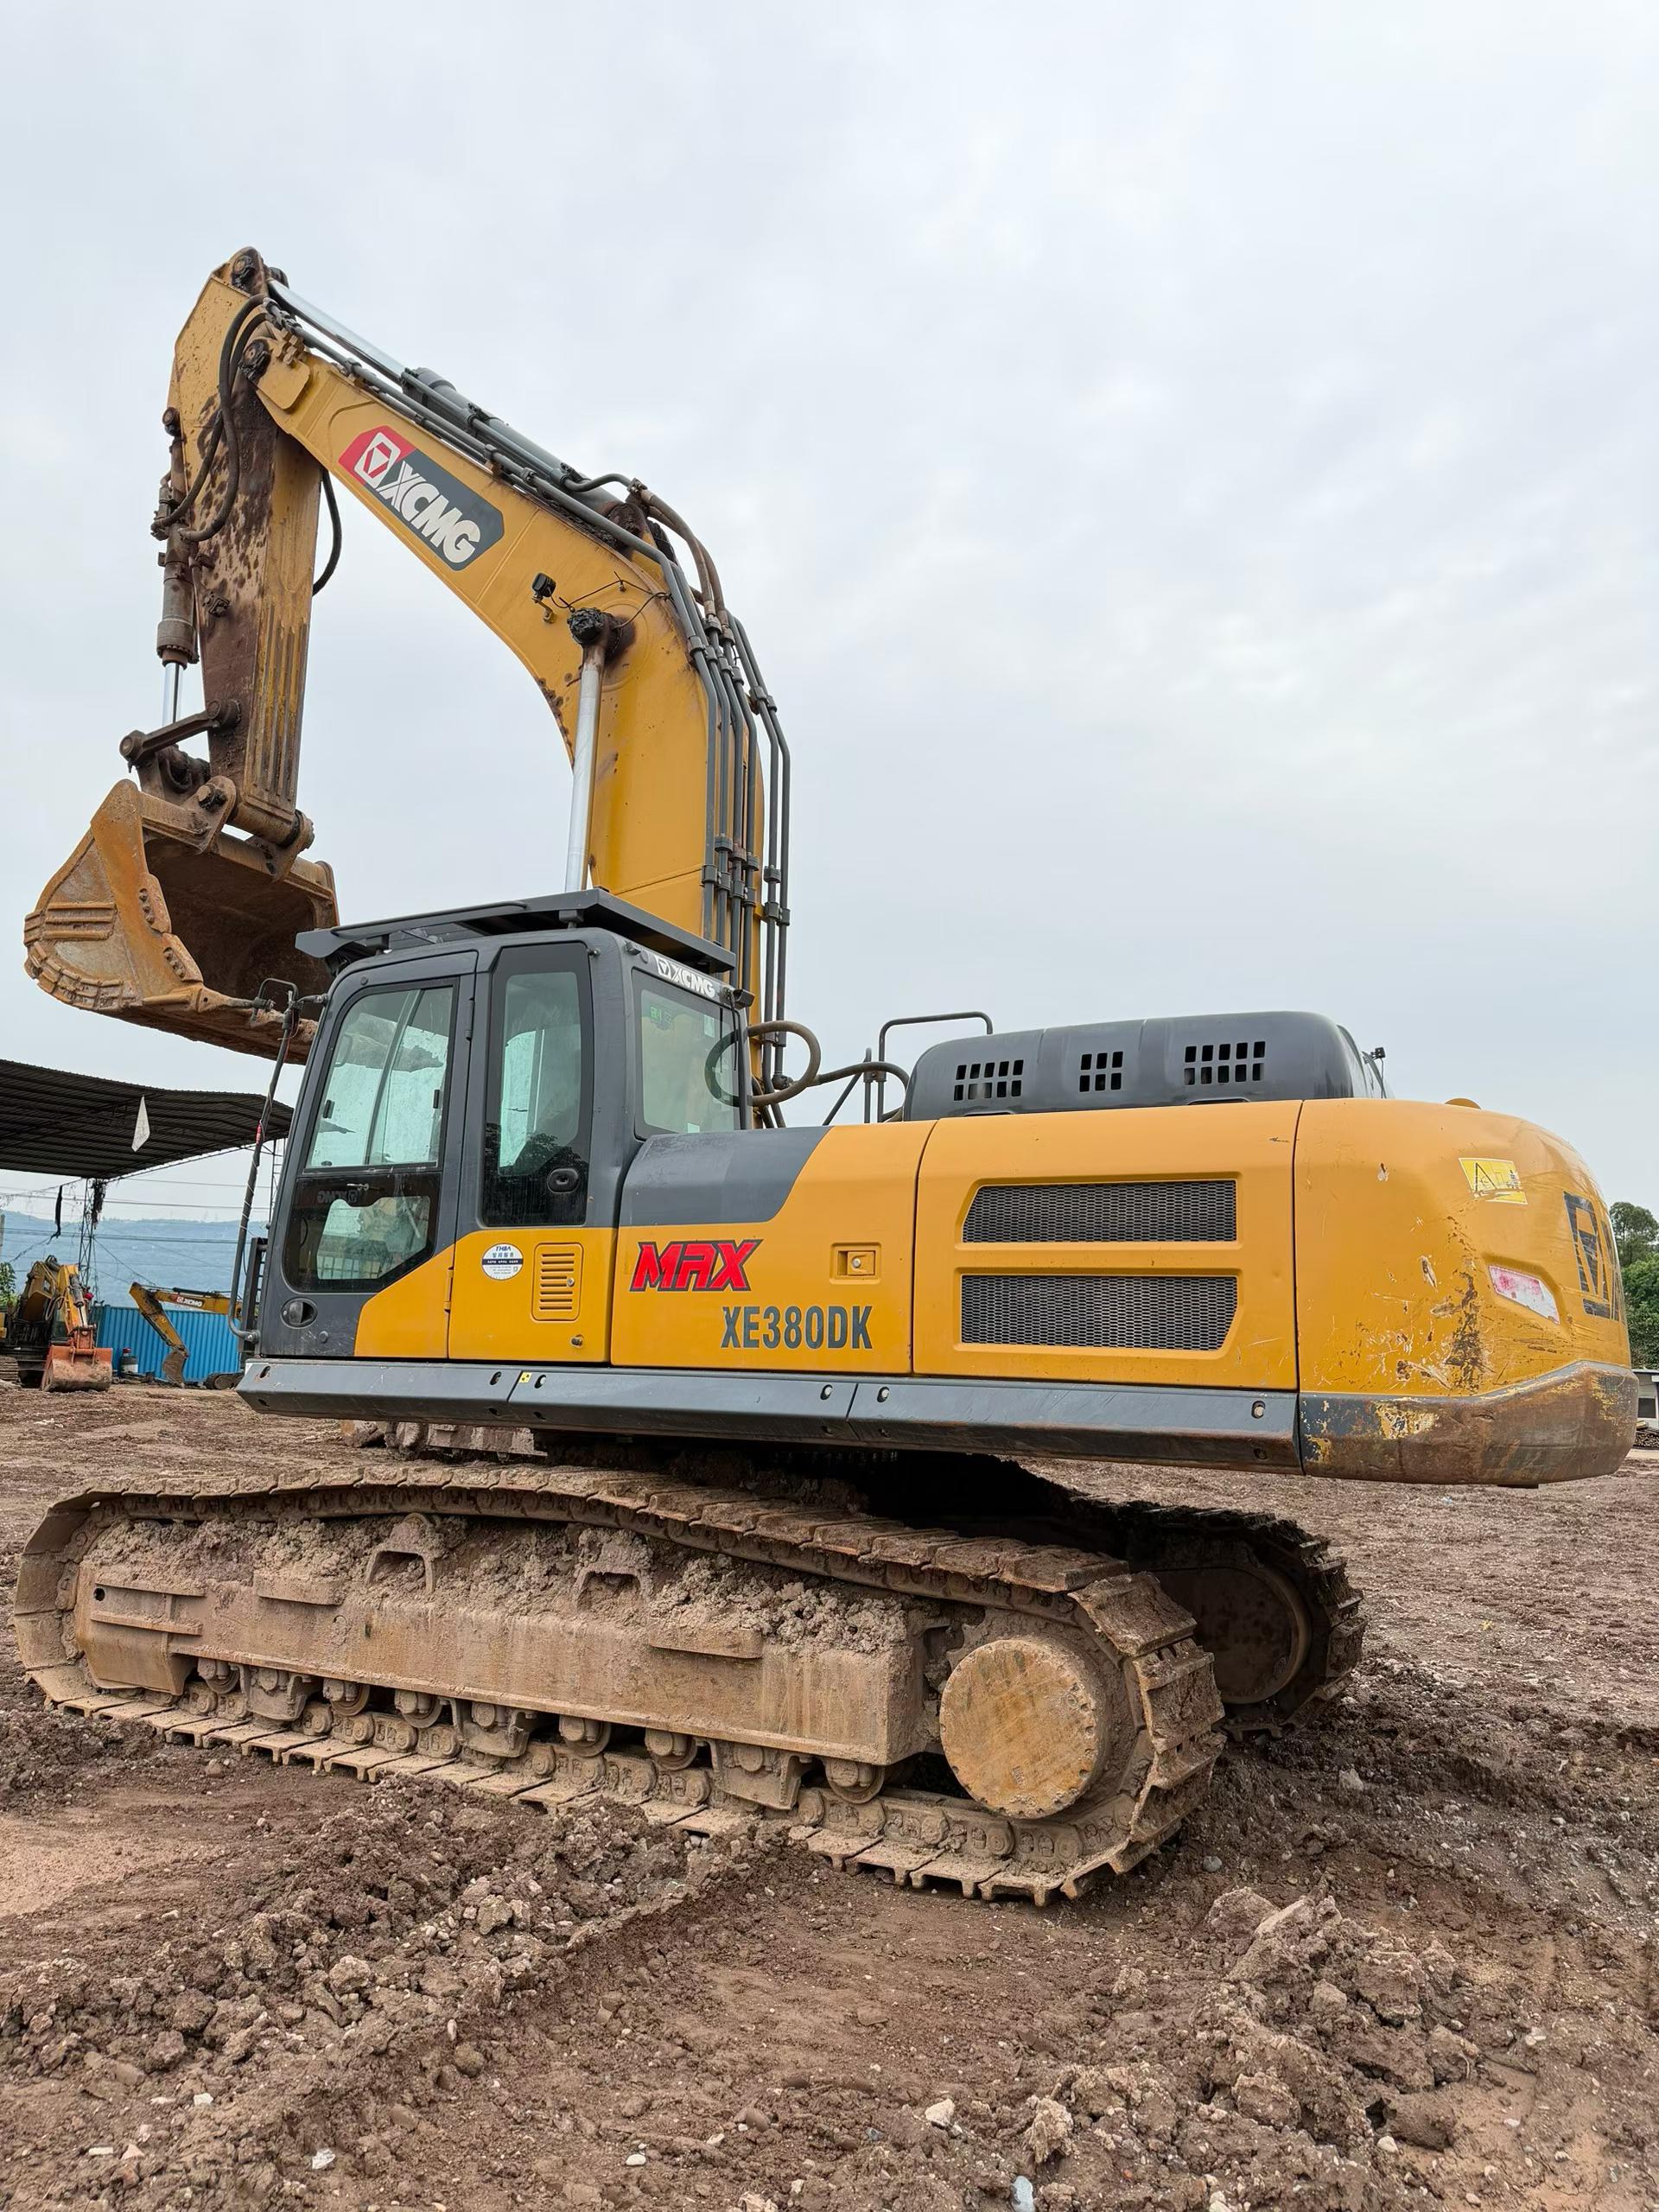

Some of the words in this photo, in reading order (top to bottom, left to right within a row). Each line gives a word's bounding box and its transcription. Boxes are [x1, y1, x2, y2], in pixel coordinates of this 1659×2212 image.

[377, 461, 480, 563] XCMG
[671, 963, 715, 999] XCMG
[629, 1239, 764, 1292] MAX
[721, 1306, 873, 1350] XE380DK
